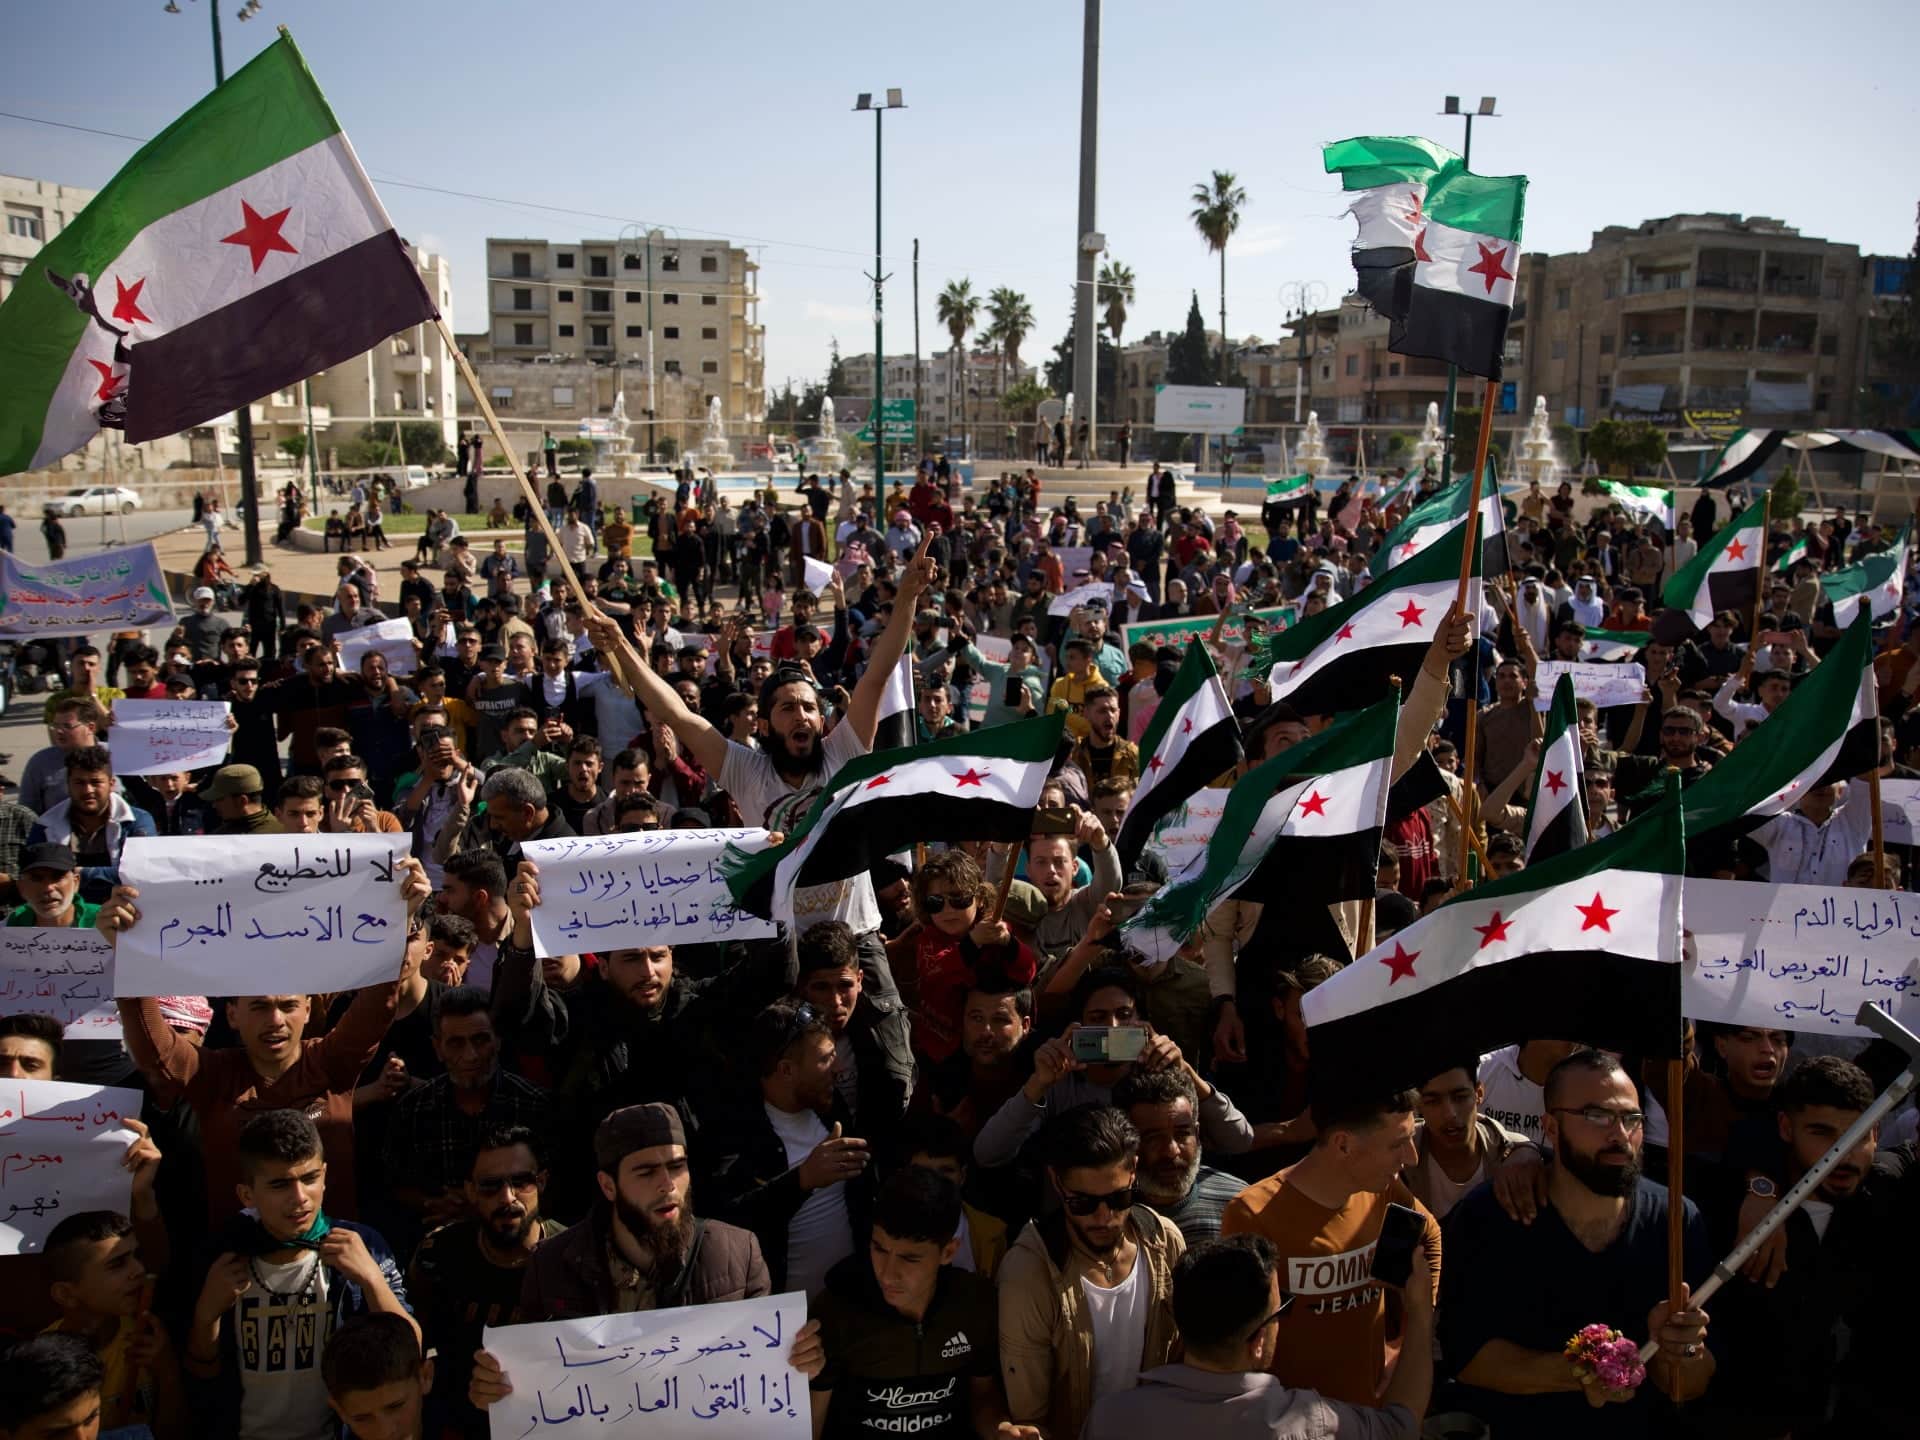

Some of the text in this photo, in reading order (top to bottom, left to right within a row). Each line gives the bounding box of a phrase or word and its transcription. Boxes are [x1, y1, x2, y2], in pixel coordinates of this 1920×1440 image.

[255, 846, 351, 893] للتطبيع
[370, 849, 394, 883] لا
[639, 861, 701, 897] ضحايا
[160, 901, 232, 960] المجرم
[352, 912, 388, 944] مع
[1793, 897, 1836, 938] الدم
[1842, 894, 1902, 940] أولياء
[1773, 988, 1892, 1024] الياسي
[92, 1102, 119, 1125] من
[2, 1151, 64, 1188] مجرم
[0, 1189, 61, 1223] فهو
[1295, 1246, 1376, 1290] TOMM
[752, 1309, 781, 1348] لا
[555, 1335, 681, 1377] ثورتنا
[941, 1344, 972, 1359] adidas
[518, 1383, 610, 1440] بالعار
[608, 1375, 679, 1424] العار
[760, 1372, 797, 1419] إذا
